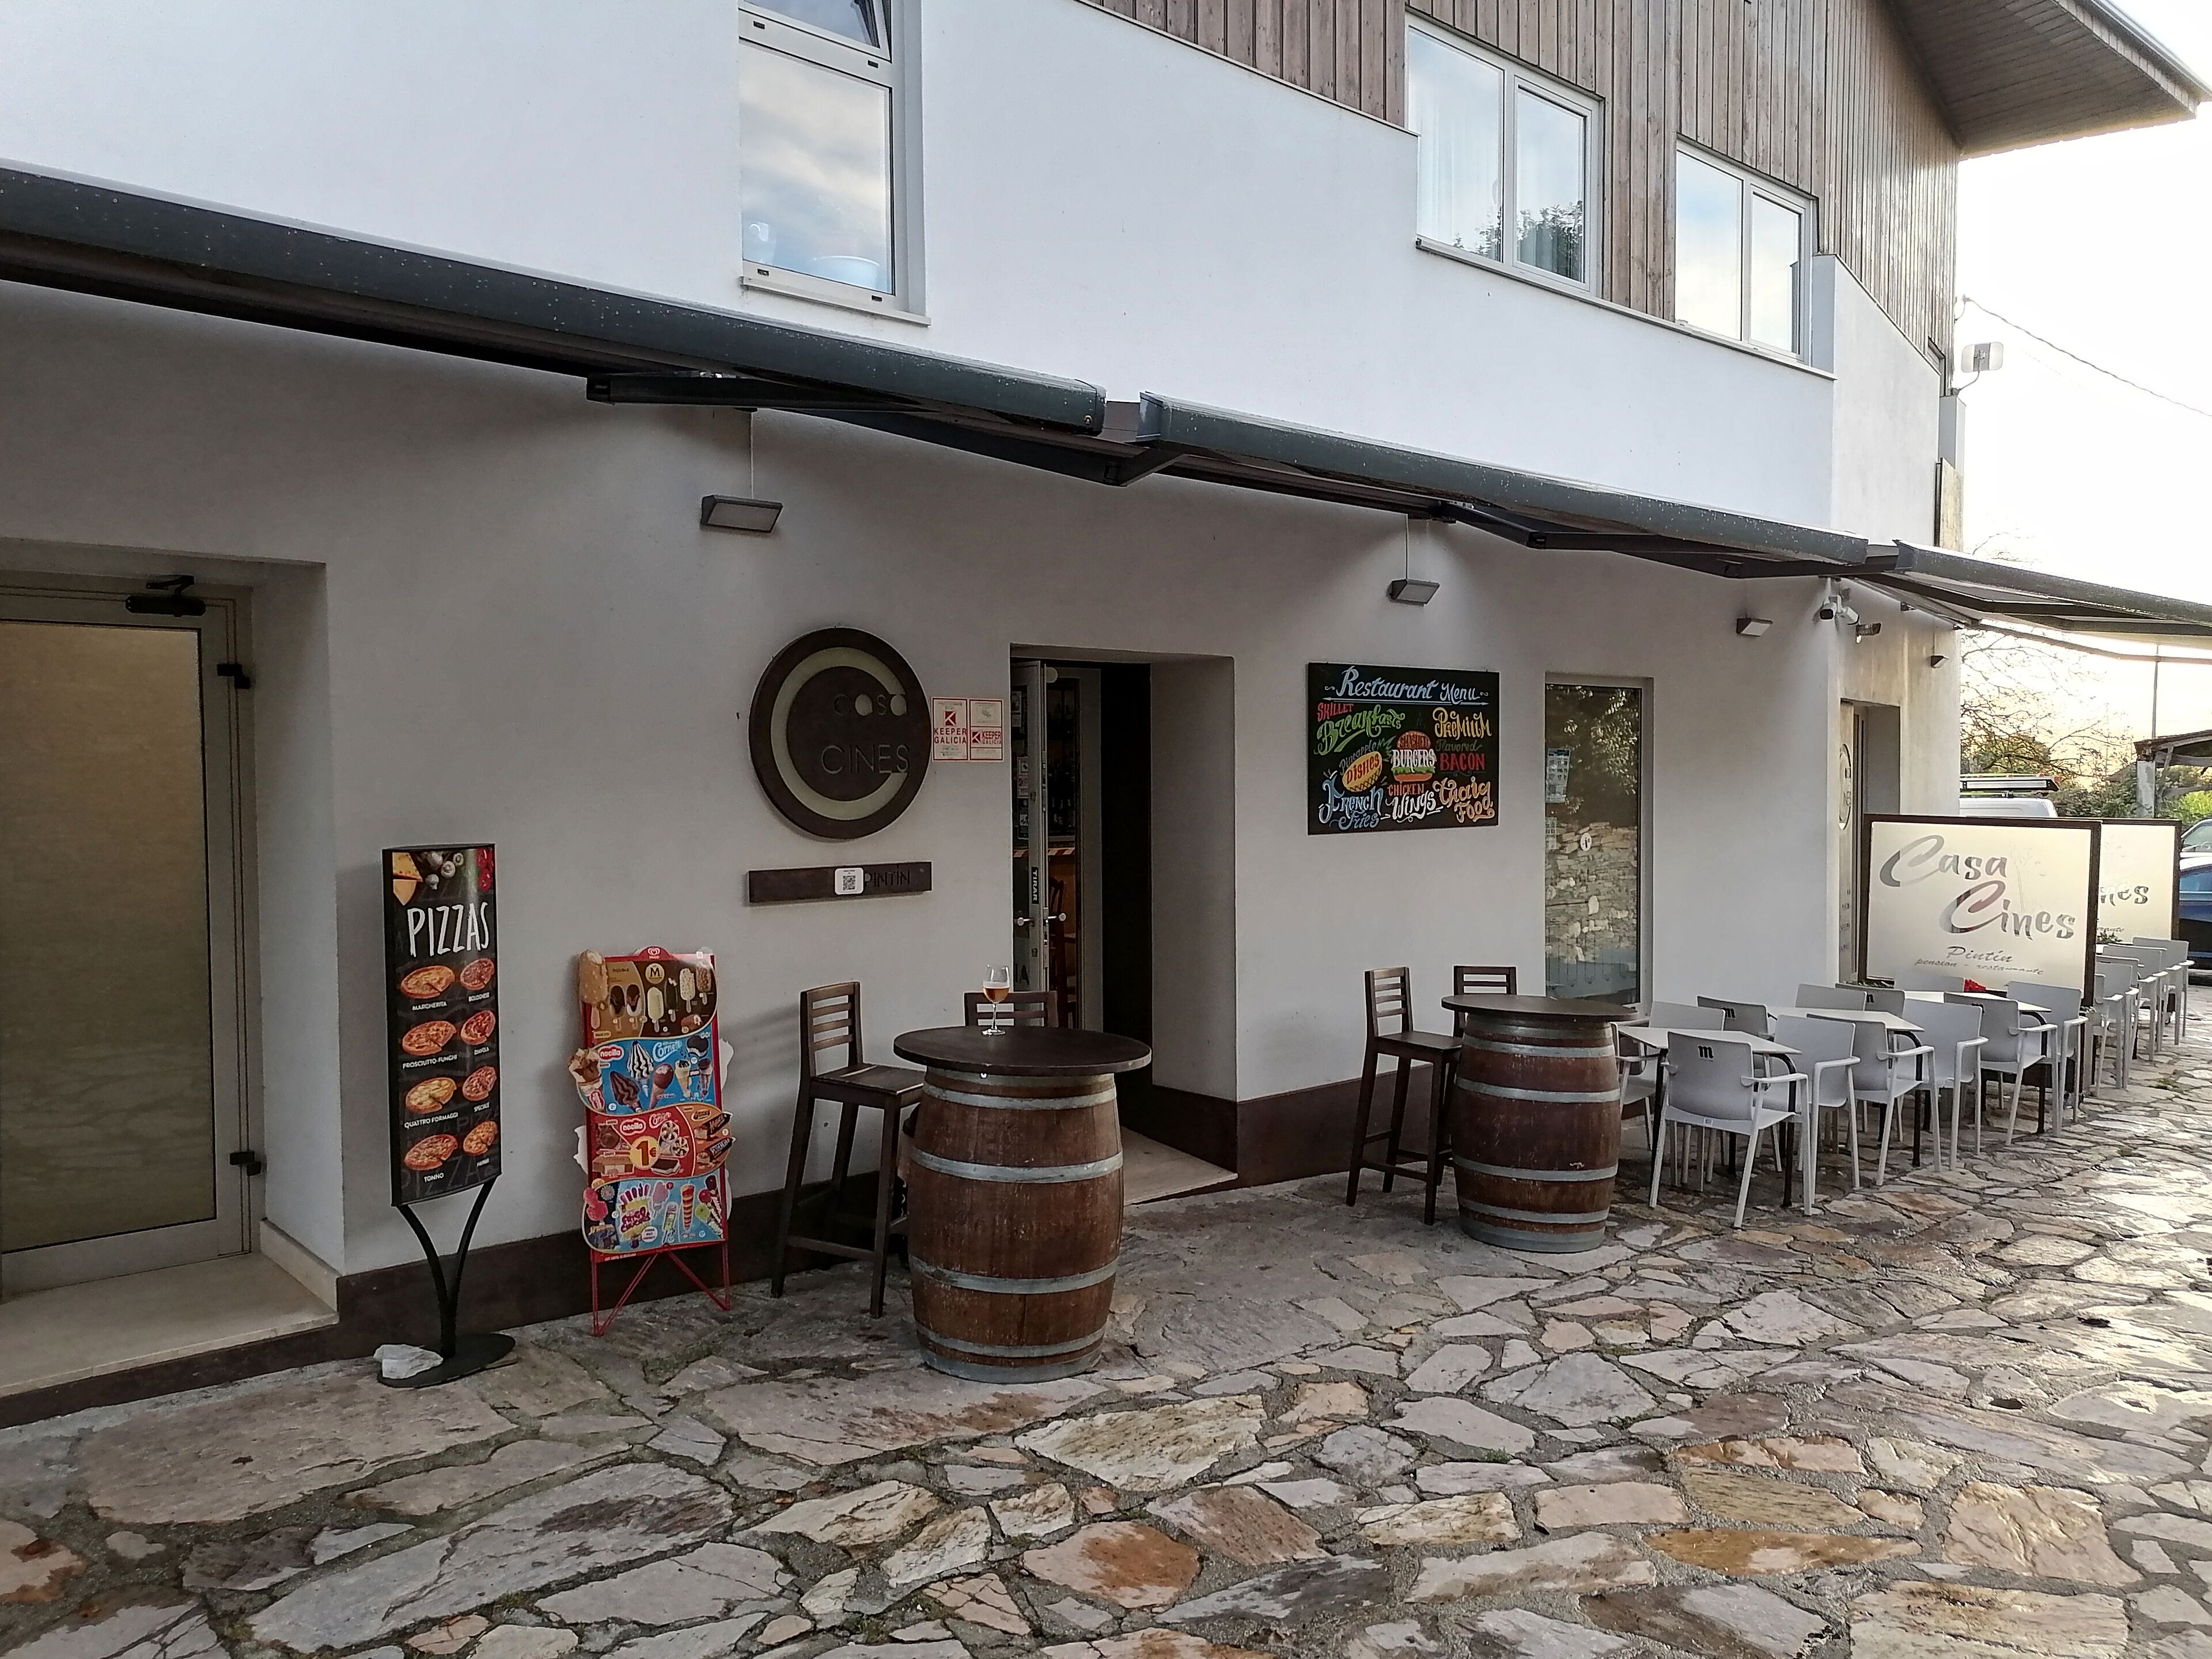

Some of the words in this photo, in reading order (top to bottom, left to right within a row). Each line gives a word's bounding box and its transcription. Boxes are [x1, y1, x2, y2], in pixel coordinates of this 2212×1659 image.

[1336, 665, 1439, 699] Restaurant
[1440, 683, 1480, 704] Menu
[982, 731, 1001, 739] KEEPER
[1314, 704, 1405, 756] Breakfasts
[1435, 738, 1482, 752] Flavored
[821, 744, 910, 774] CINES
[1339, 740, 1377, 775] Pineapple
[1392, 748, 1435, 770] BURGERS
[1441, 753, 1485, 771] BACON
[1334, 810, 1379, 830] Fries
[1879, 835, 2008, 887] Casa
[2100, 885, 2149, 906] nes
[1940, 880, 2075, 941] Cines
[407, 902, 489, 957] PIZZAS
[1947, 946, 2013, 963] Pintín
[650, 967, 660, 978] M
[412, 1001, 447, 1011] MARGHERITA
[600, 1049, 620, 1057] nocilla
[404, 1118, 431, 1129] QUATTRO
[431, 1112, 459, 1123] FORMAGGI
[424, 1172, 444, 1183] TONNO
